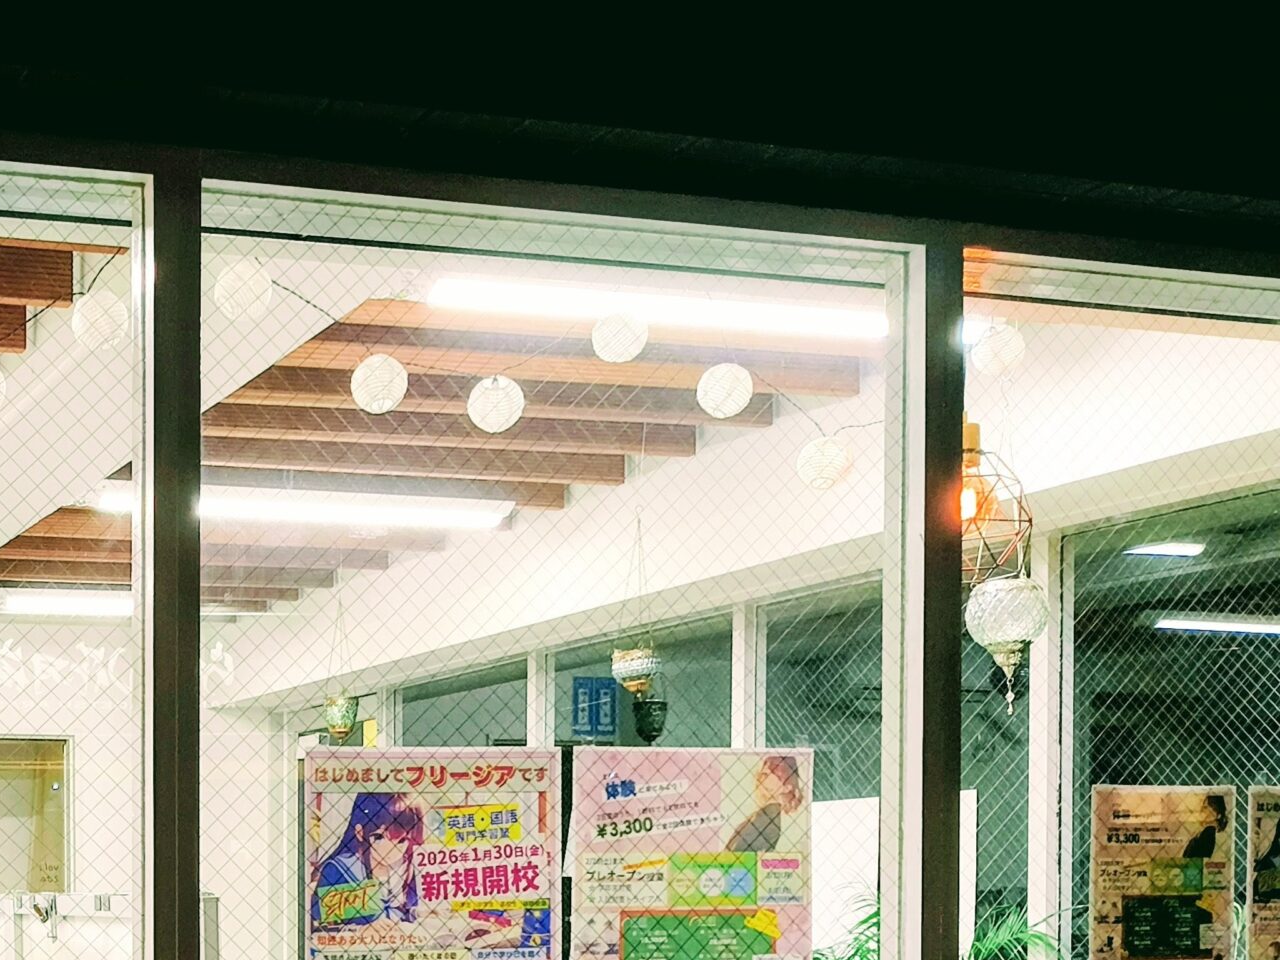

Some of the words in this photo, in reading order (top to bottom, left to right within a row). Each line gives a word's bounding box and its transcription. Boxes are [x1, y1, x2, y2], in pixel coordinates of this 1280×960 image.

[314, 765, 548, 788] はじめましてフリージアです
[597, 817, 653, 839] ¥3,300
[417, 844, 545, 867] 2026年1月30日(金)
[421, 862, 540, 901] 新規開校
